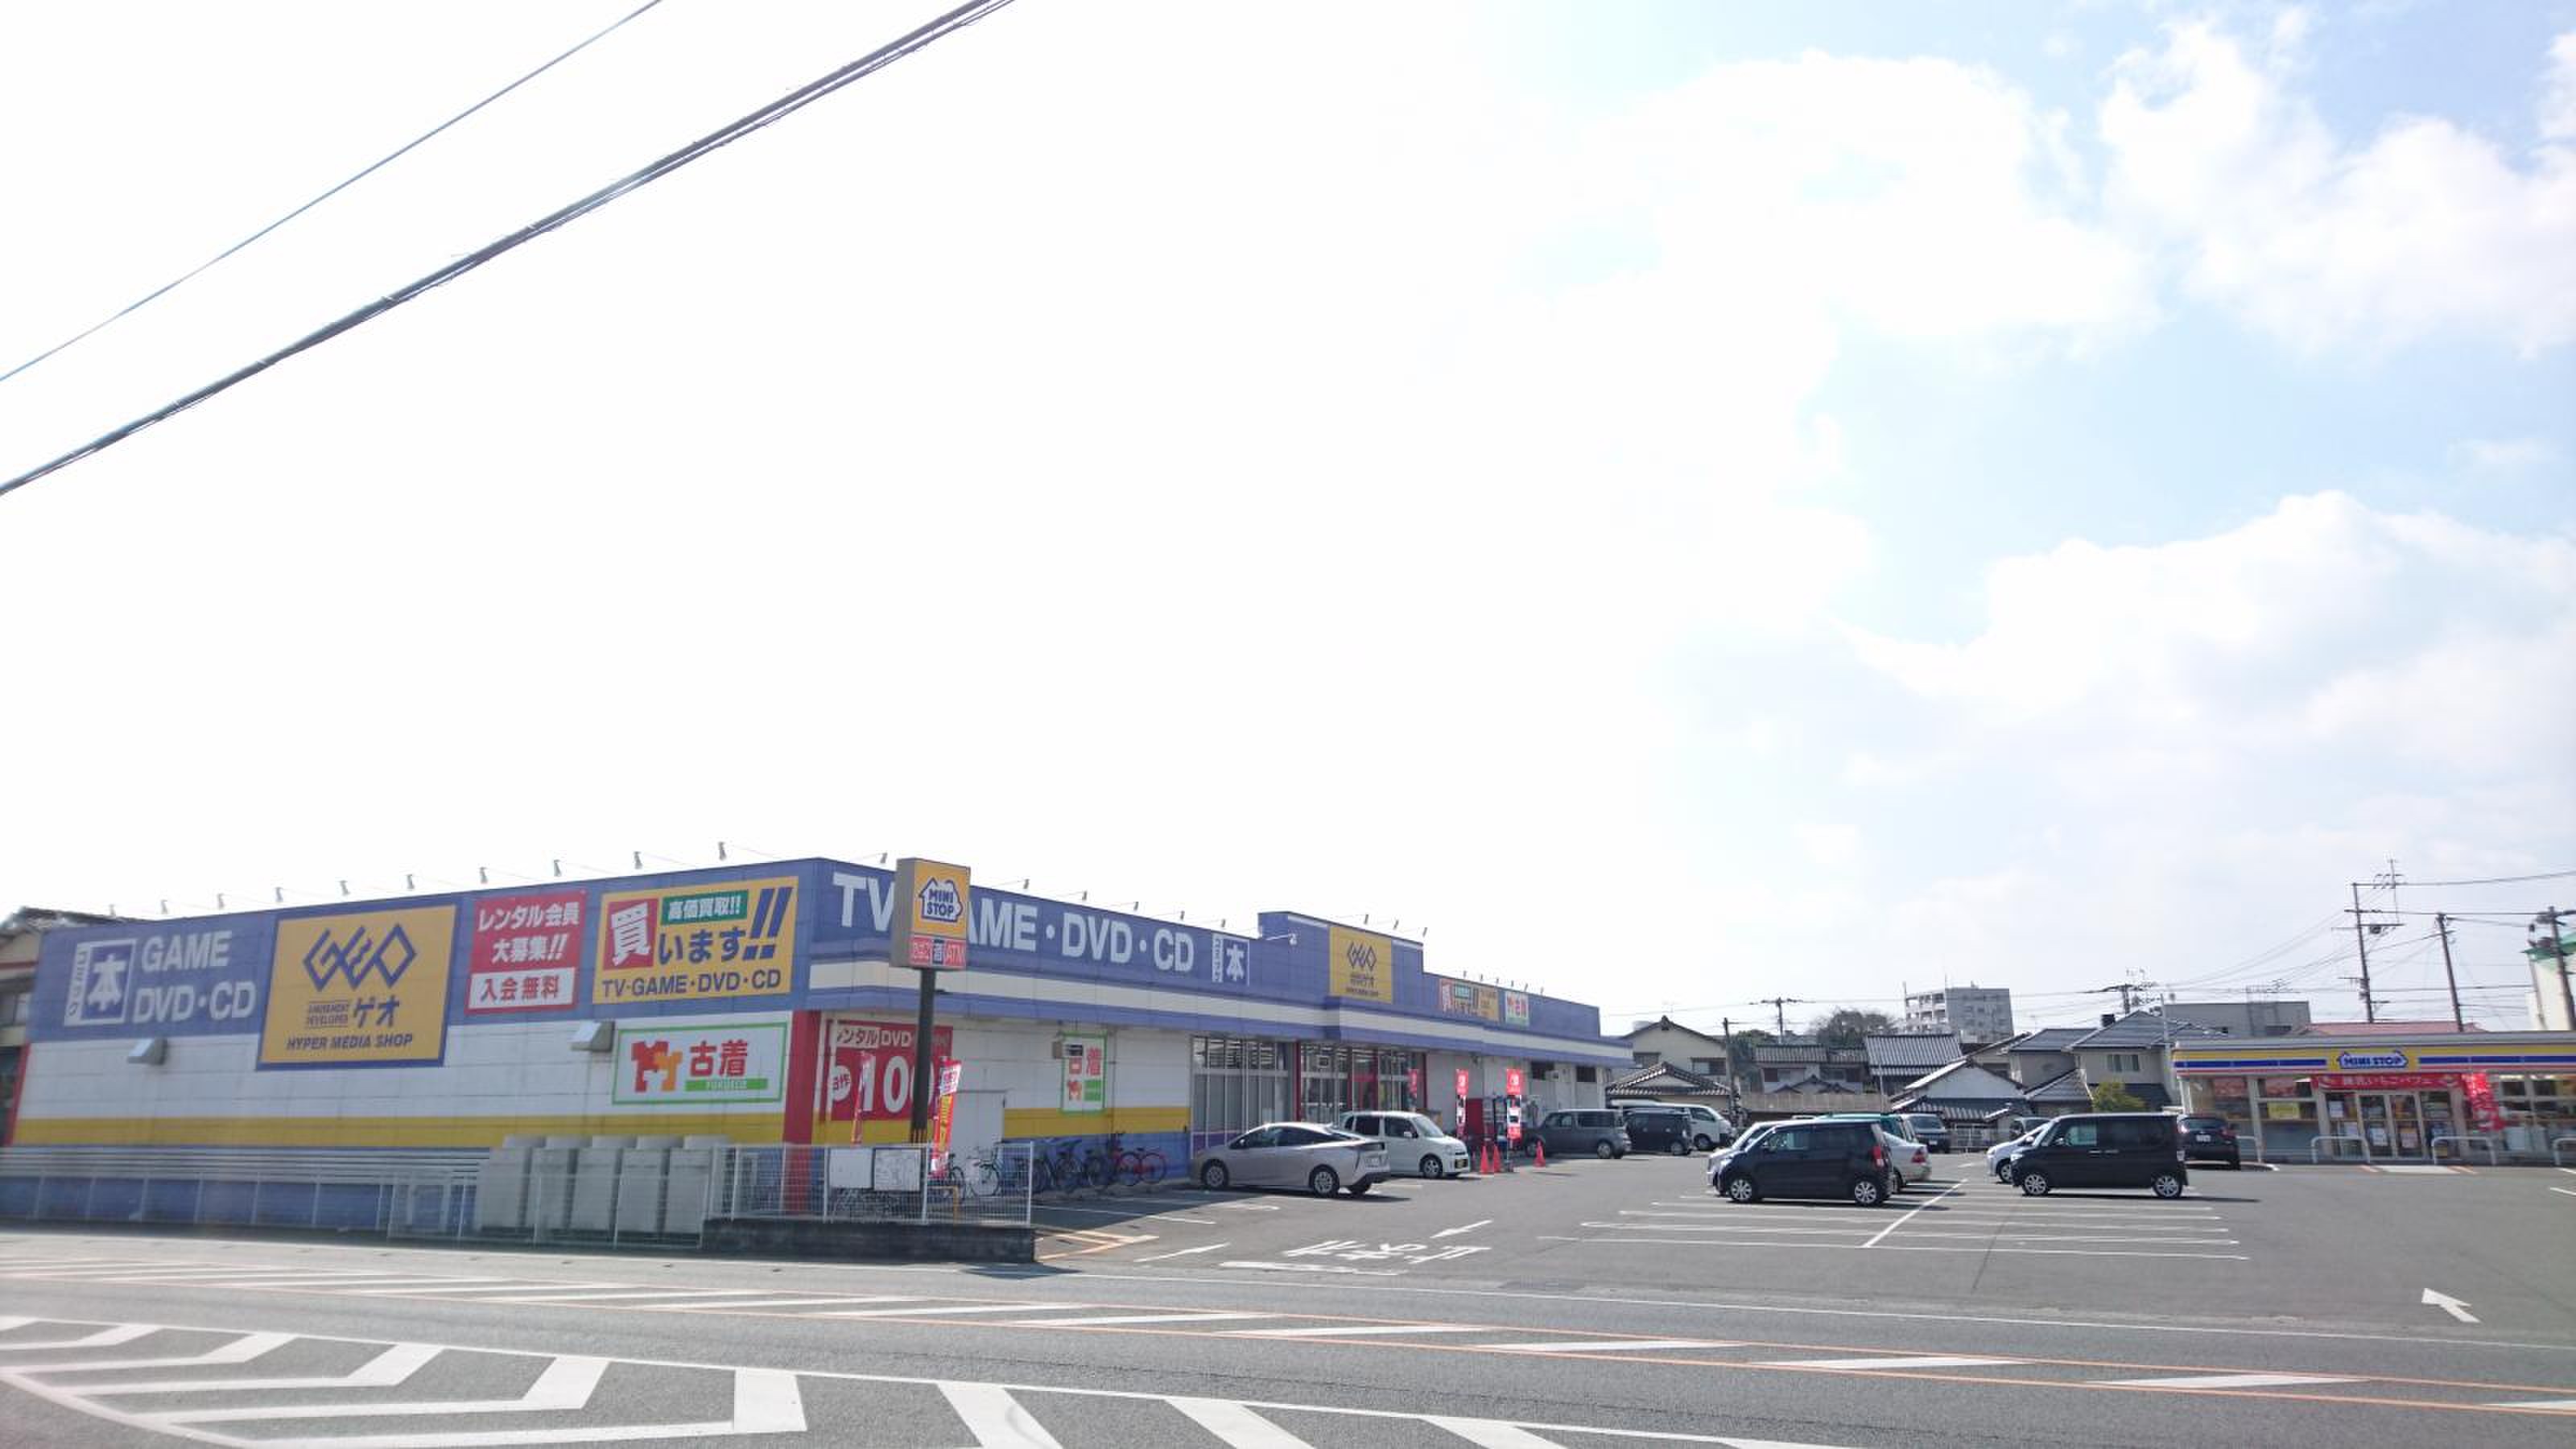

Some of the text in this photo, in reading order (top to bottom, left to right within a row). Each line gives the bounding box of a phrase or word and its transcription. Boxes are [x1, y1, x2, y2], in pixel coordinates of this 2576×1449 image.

[927, 902, 955, 916] STOP
[928, 889, 953, 902] MINI
[479, 902, 580, 931] レンタル会員
[141, 931, 232, 972] GAME
[87, 953, 126, 1012] 本
[481, 976, 559, 1001] 入会無料
[353, 995, 400, 1028] ゲオ
[287, 1033, 413, 1050] HYPER MEDIA SHOP
[690, 1039, 748, 1077] 古着
